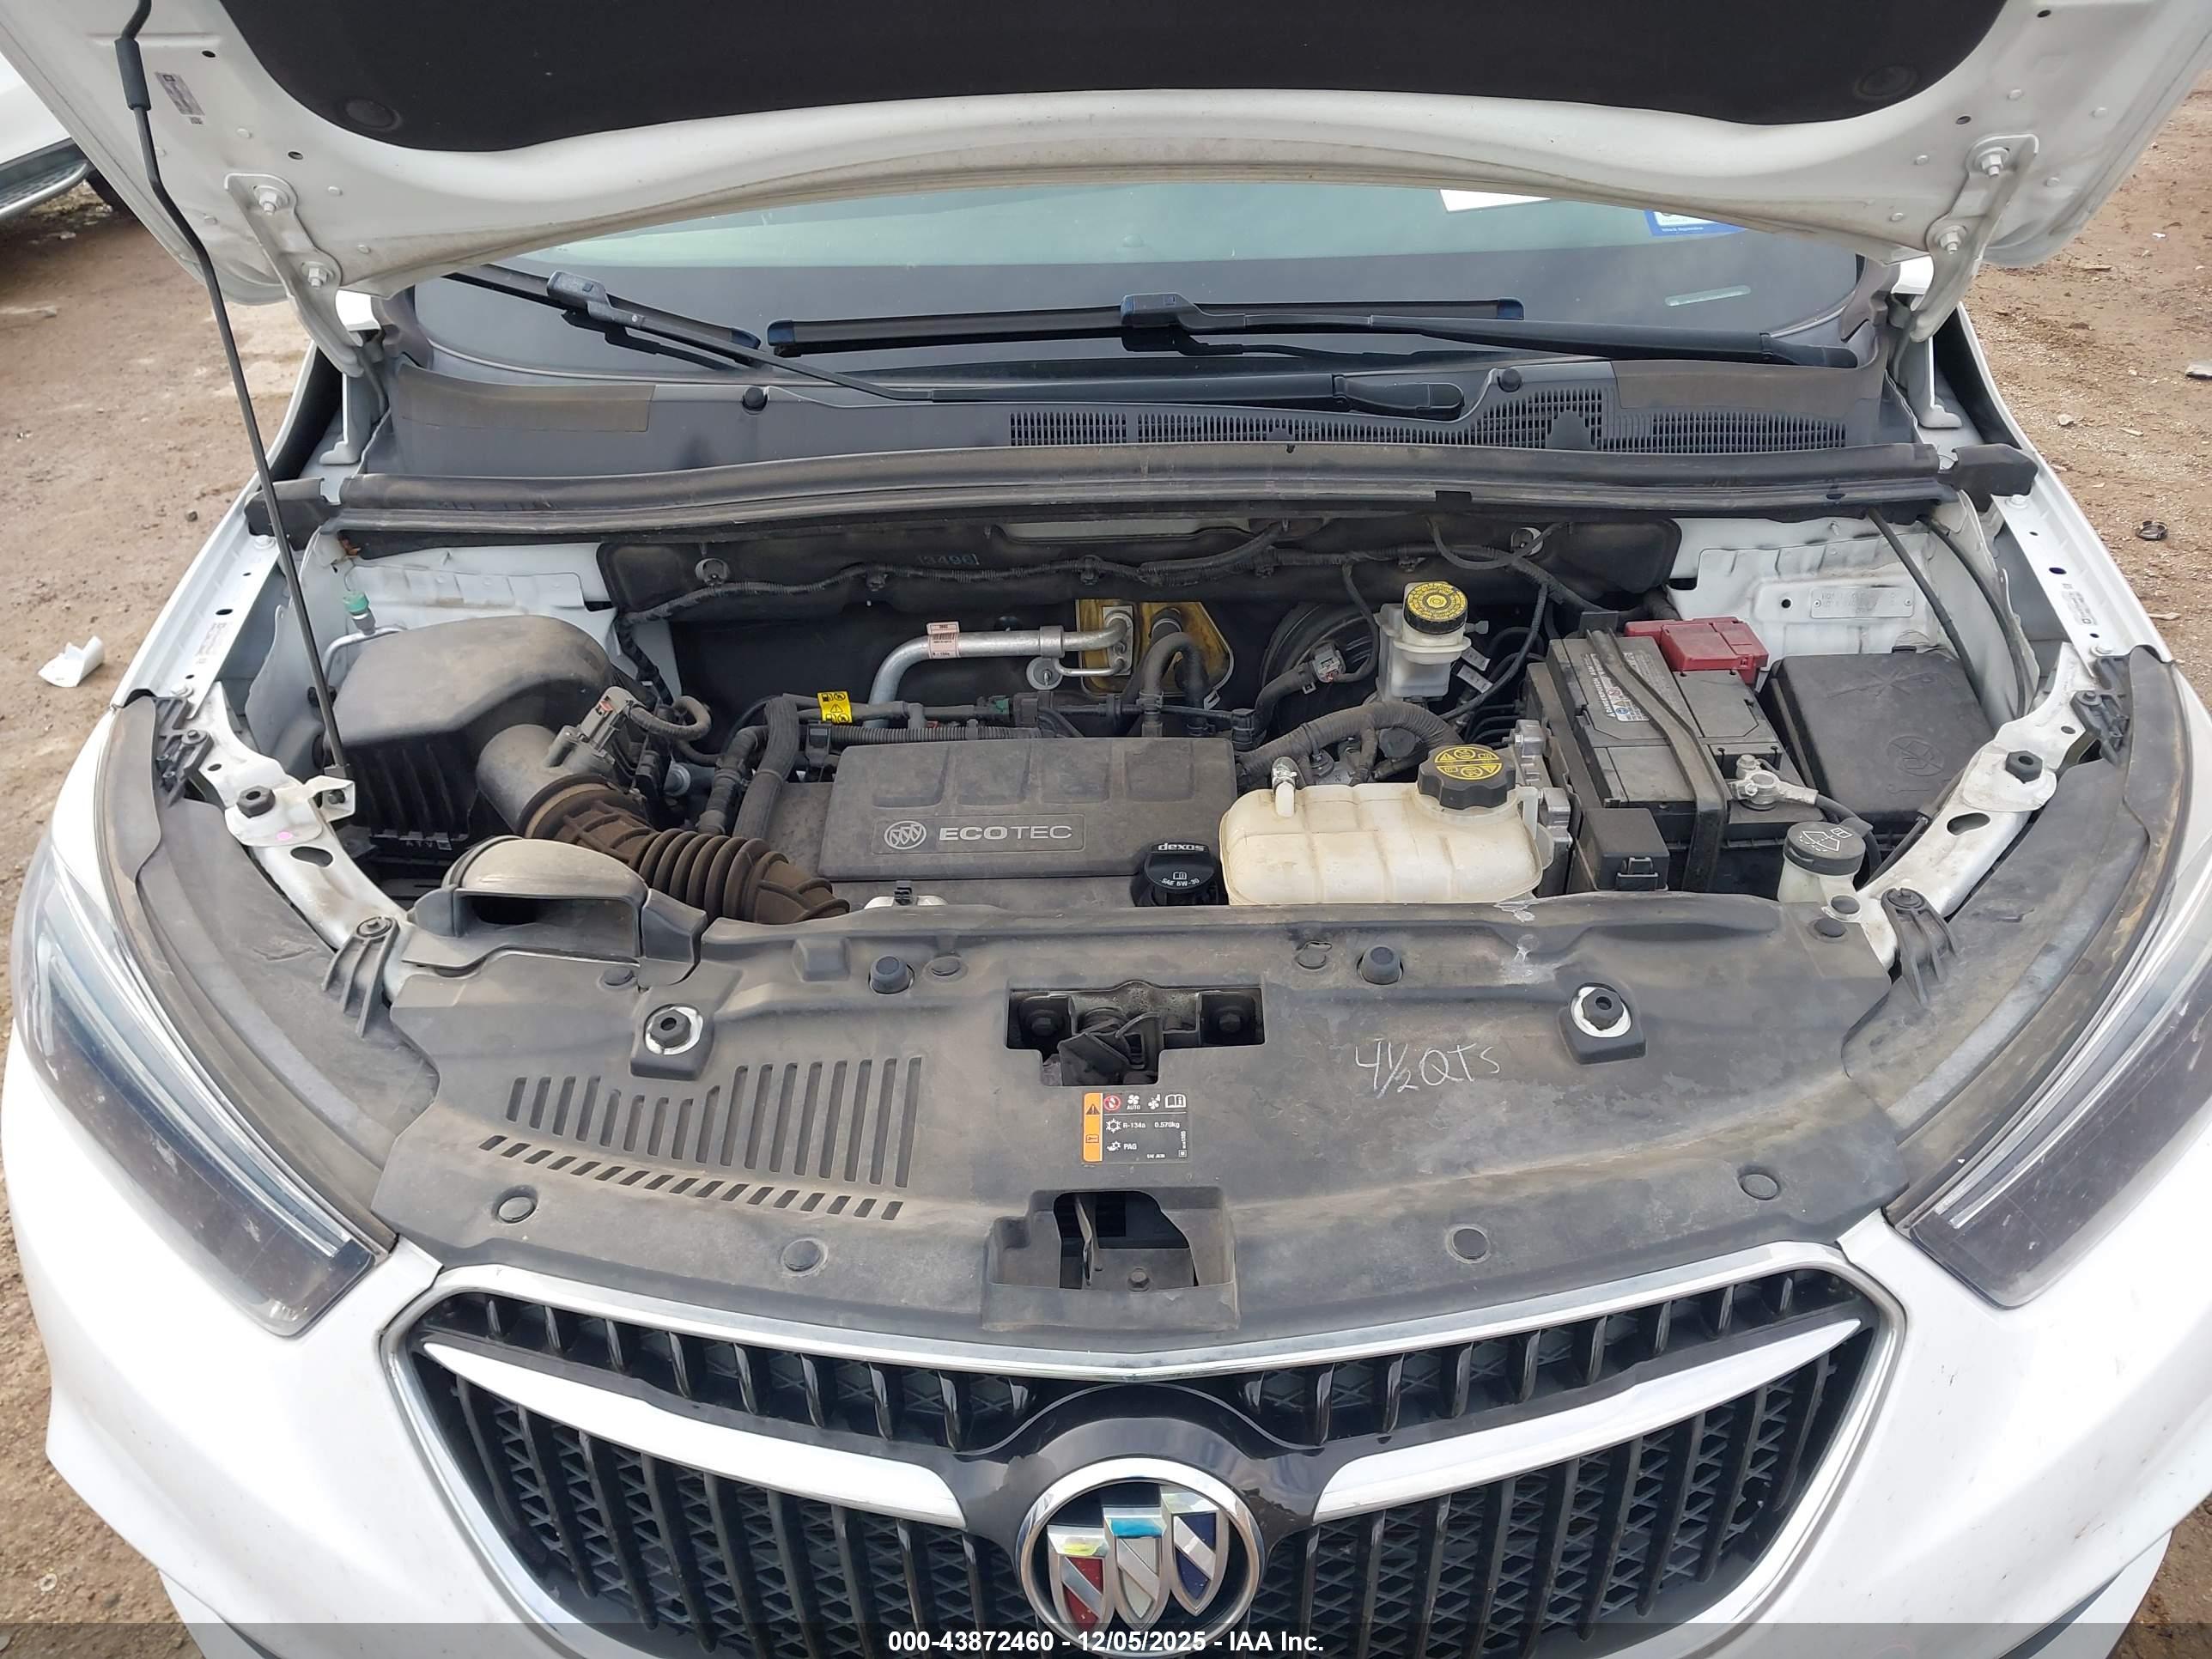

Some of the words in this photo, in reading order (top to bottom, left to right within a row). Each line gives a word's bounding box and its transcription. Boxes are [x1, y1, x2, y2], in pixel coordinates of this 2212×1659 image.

[939, 825, 1073, 841] ECOTEC
[1158, 842, 1204, 852] dexos
[1161, 878, 1176, 886] SAE
